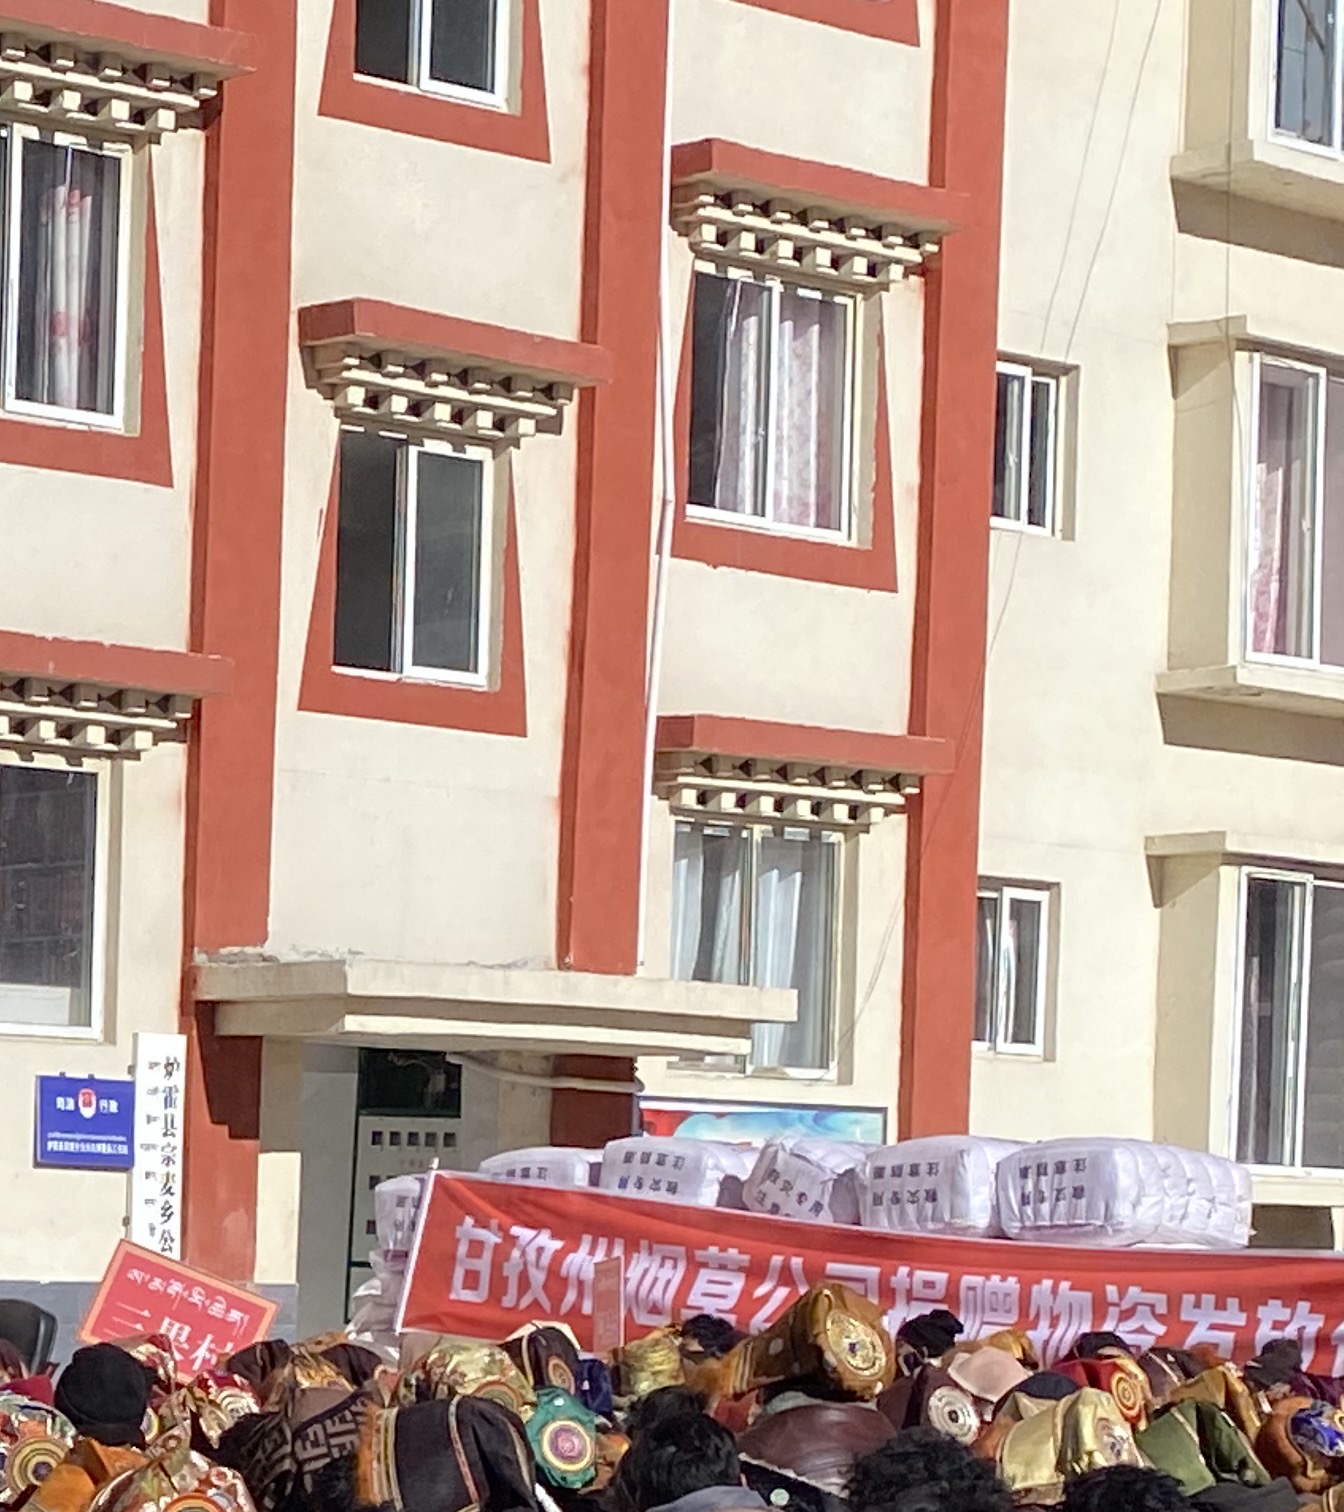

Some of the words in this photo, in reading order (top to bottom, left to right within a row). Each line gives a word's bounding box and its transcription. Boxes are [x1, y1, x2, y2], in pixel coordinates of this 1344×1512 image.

[449, 1215, 1344, 1378] 甘孜州烟草公捐赠物资发放
